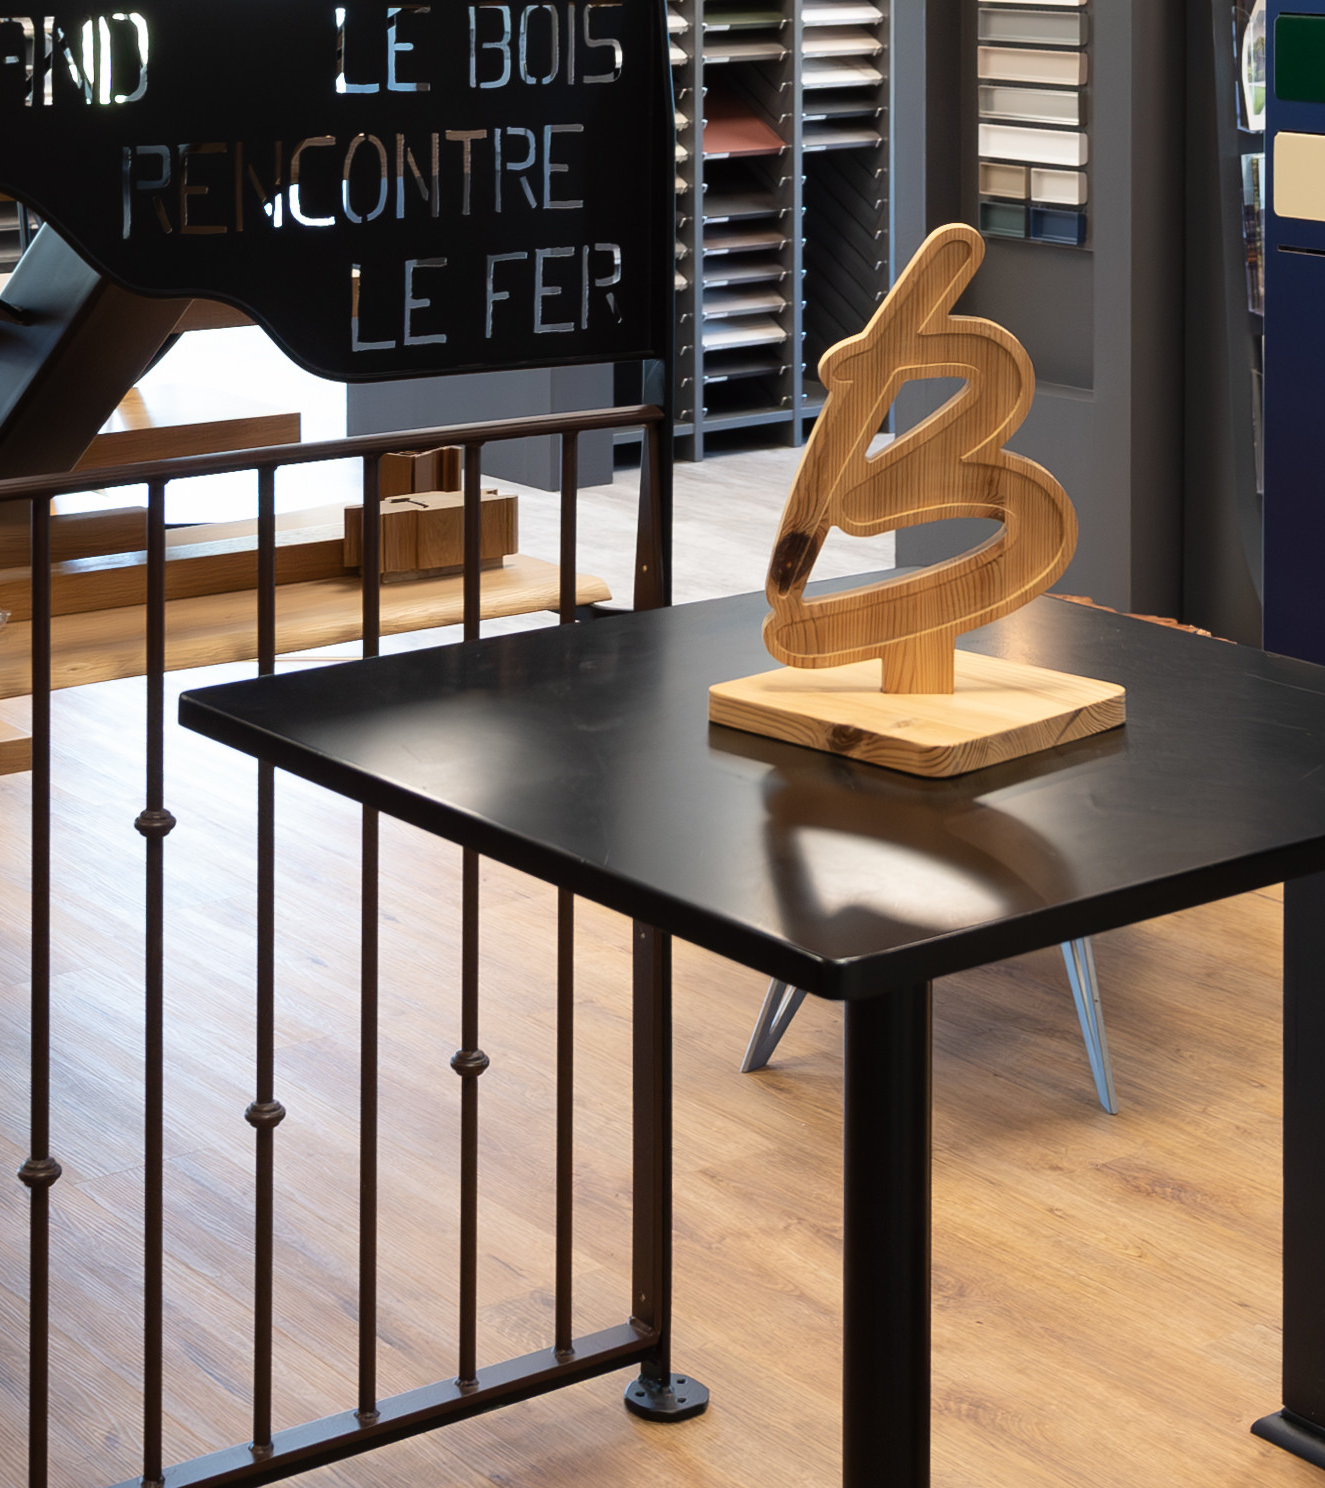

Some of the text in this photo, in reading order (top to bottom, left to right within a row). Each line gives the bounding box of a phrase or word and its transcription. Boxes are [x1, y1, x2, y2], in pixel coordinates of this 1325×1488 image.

[335, 4, 431, 94] LE
[468, 0, 624, 89] BOIS
[122, 123, 584, 240] RENCONTRE
[350, 242, 623, 353] LE FER
